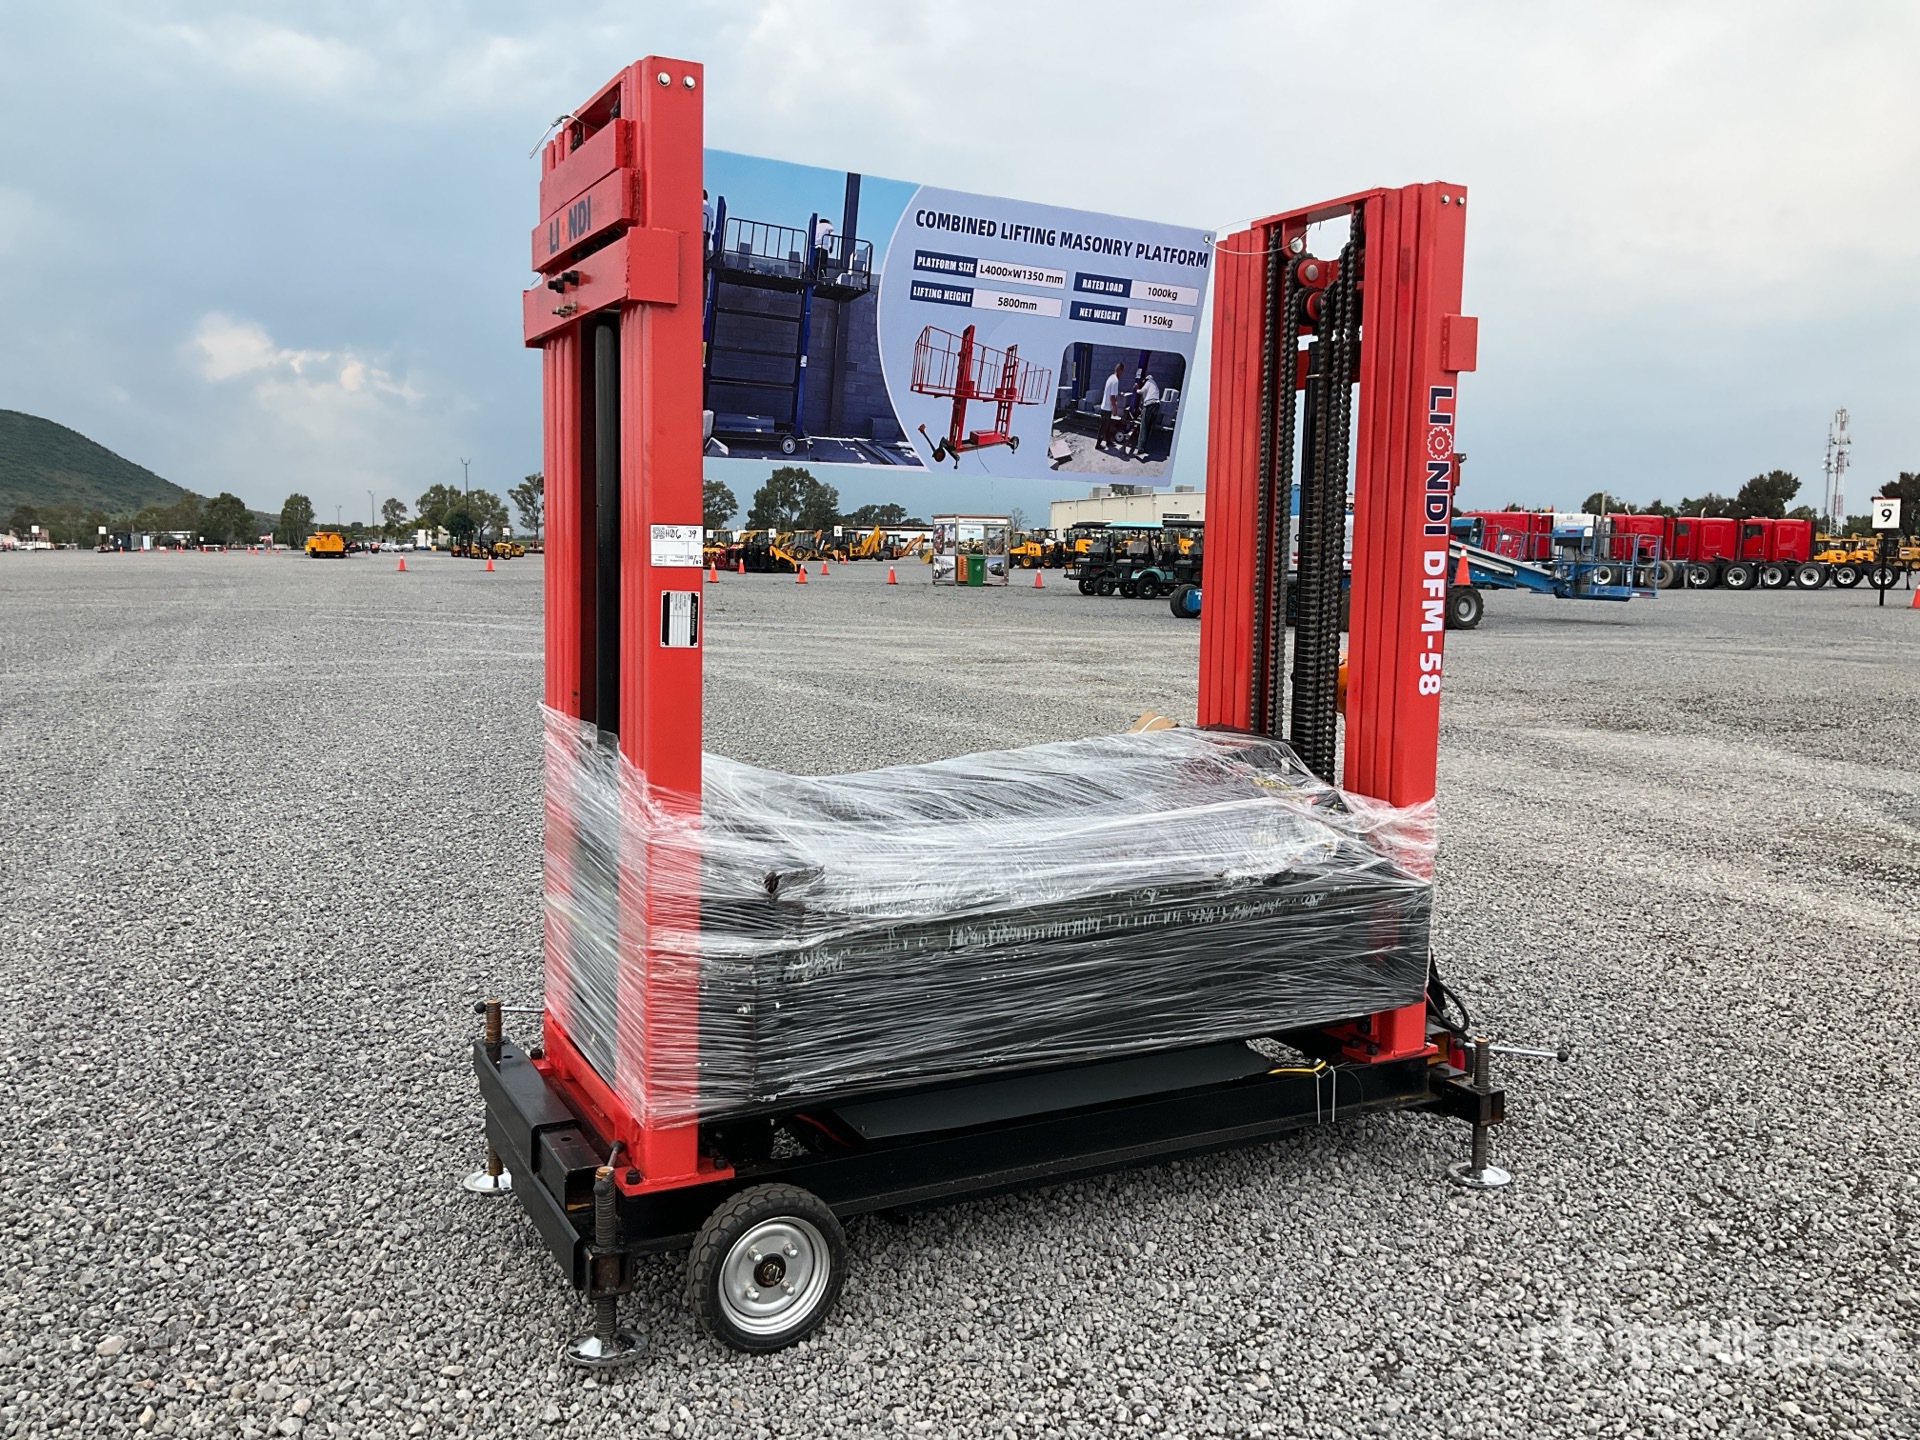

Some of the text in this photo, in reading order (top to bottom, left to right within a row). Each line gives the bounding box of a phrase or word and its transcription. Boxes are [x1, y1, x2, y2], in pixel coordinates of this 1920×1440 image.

[916, 209, 1209, 268] COMBINED LIFTING MASONRY PLATFORM
[917, 256, 975, 273] PLATFORM SIZE
[1046, 273, 1063, 284] mm
[1082, 279, 1124, 293] RATED LOAD
[913, 286, 972, 303] LIFTING HEIGHT
[1148, 287, 1178, 301] 1000kg
[997, 297, 1037, 311] 5800mm
[1079, 307, 1121, 321] NET WEIGHT
[1143, 314, 1173, 328] 1150kg
[1881, 508, 1892, 522] 9
[1418, 386, 1454, 696] LIONDI DFM-58
